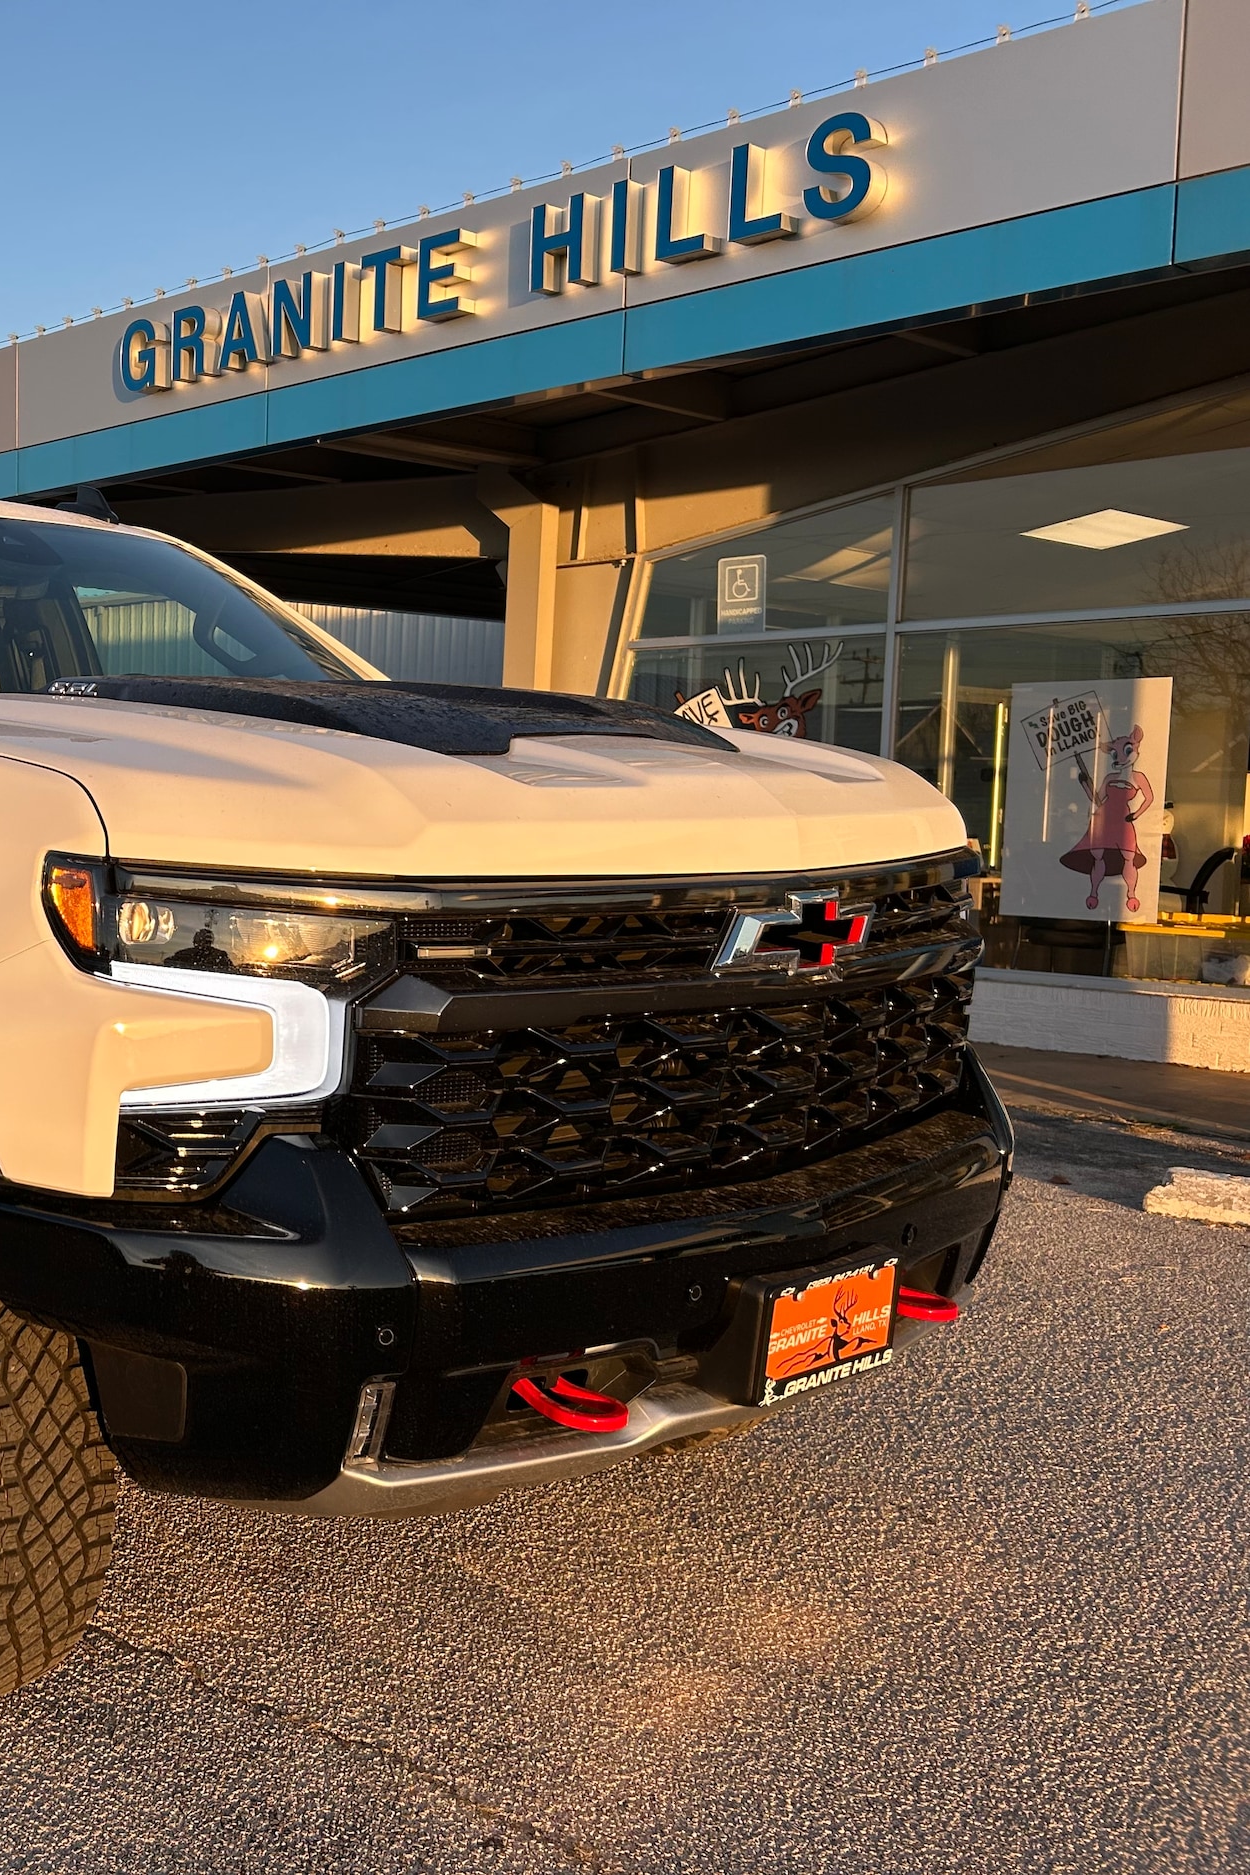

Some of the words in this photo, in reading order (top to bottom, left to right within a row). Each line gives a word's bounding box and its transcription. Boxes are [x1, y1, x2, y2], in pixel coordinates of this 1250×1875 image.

[121, 227, 477, 392] GRANITE
[529, 111, 888, 296] HILLS
[721, 606, 763, 617] HANDICAPPED
[1067, 700, 1087, 716] BIG
[1036, 710, 1095, 748] DOUGH
[768, 1324, 829, 1355] GRANITE
[852, 1304, 892, 1327] HILLS
[780, 1319, 818, 1338] CHEVROLET
[852, 1322, 876, 1336] LLANO,
[878, 1318, 888, 1328] TX
[784, 1361, 853, 1398] GRANITE
[851, 1347, 894, 1375] HILLS
